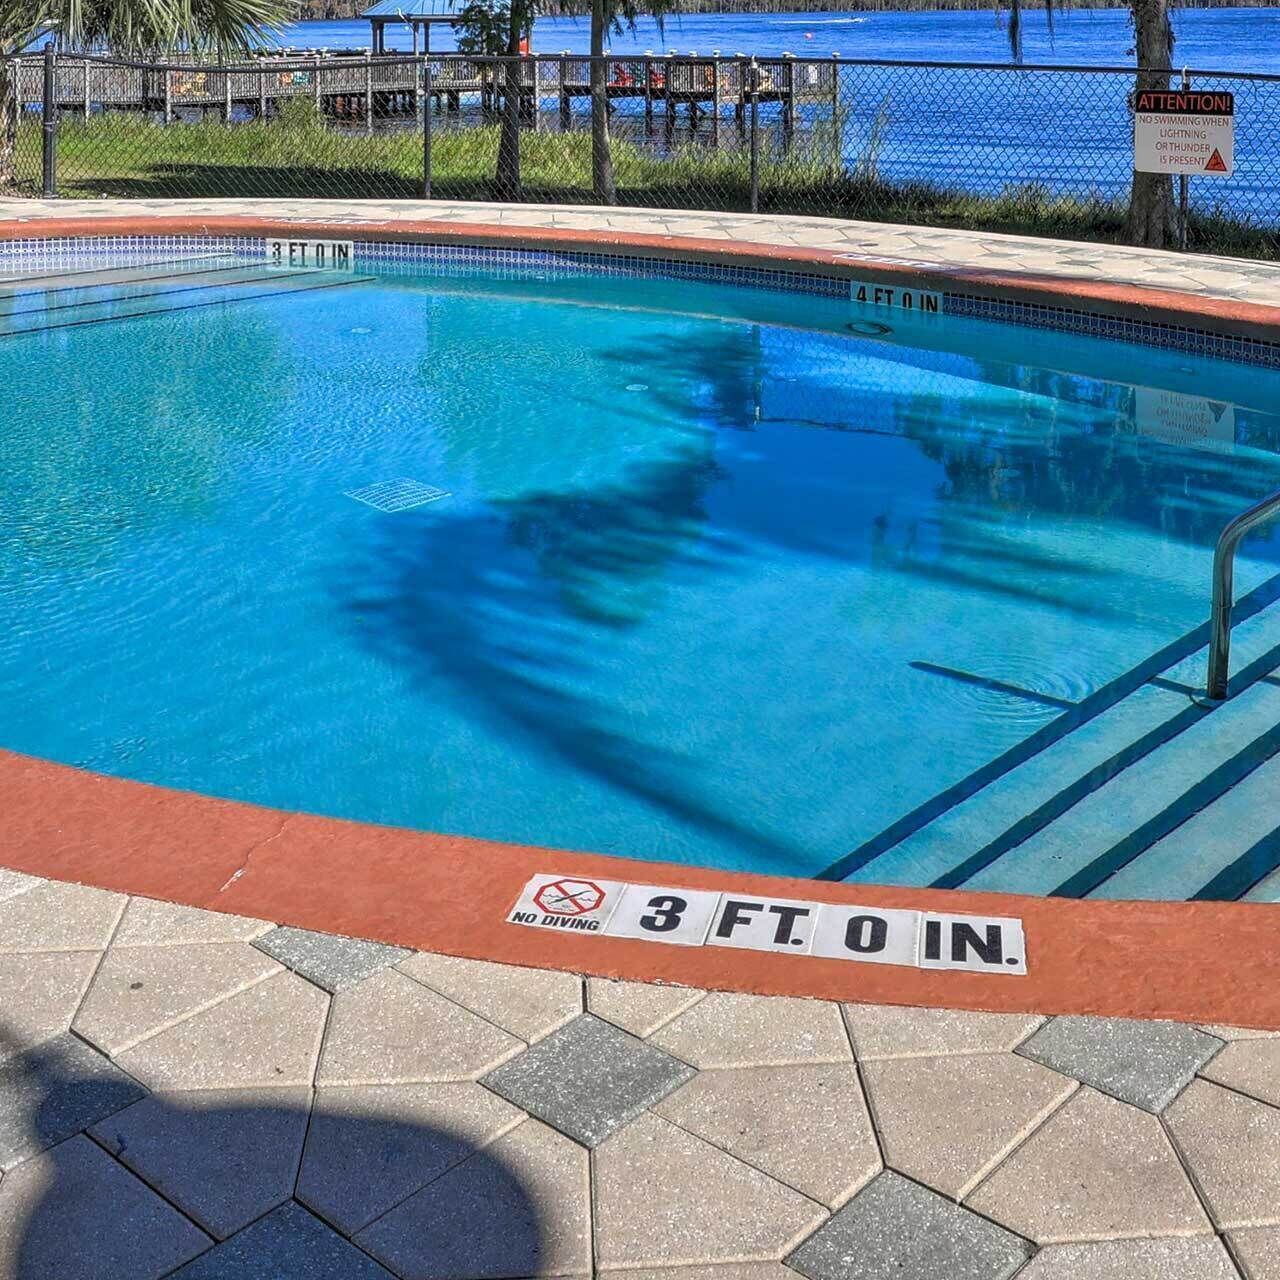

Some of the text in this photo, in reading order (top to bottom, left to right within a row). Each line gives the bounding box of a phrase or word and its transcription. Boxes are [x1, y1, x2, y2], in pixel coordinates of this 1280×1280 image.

[1138, 94, 1230, 111] ATTENTION!
[1140, 116, 1229, 127] NO SWIMMING WHEN
[1160, 129, 1207, 139] LIGHTNING
[1155, 141, 1211, 152] OR THUNDER
[1160, 155, 1206, 166] IS PRESENT
[272, 241, 349, 258] 3 FT 0 IN
[856, 285, 938, 312] 4 FT 0 IN
[512, 911, 600, 931] NO DIVING
[640, 895, 1019, 965] 3 FT. 0 IN.
